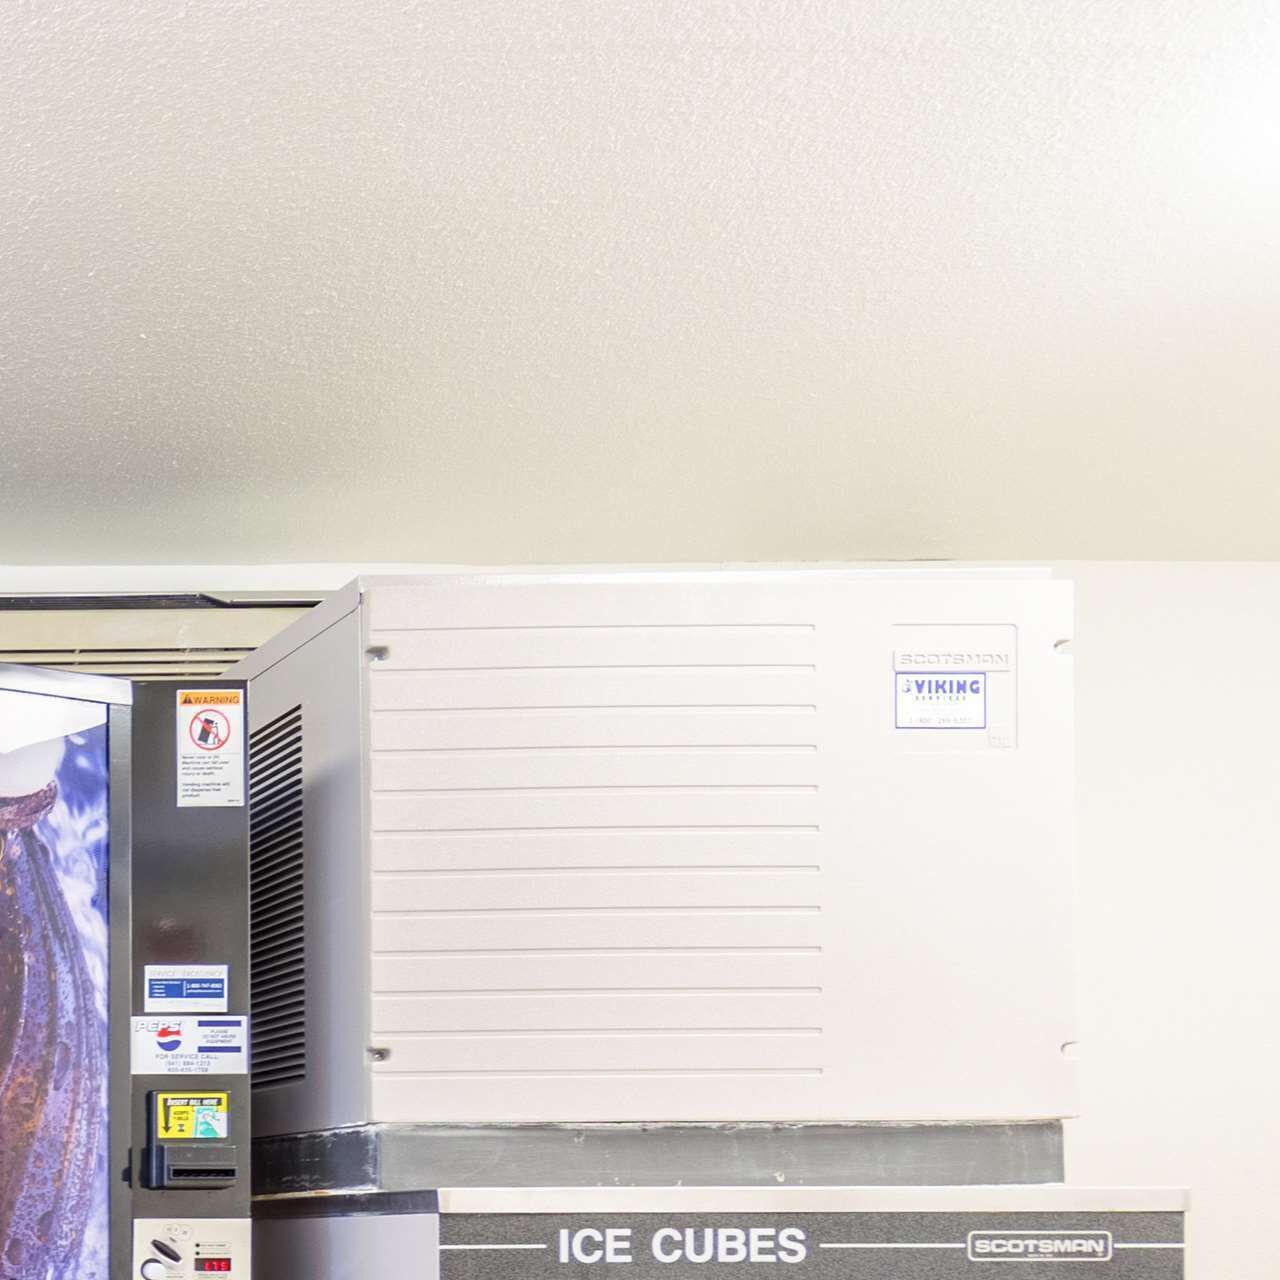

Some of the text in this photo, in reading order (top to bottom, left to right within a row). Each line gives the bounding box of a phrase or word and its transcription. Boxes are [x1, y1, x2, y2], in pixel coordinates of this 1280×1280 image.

[900, 654, 1009, 665] SCOTSMAN
[914, 680, 981, 694] VIKING
[193, 695, 239, 704] WARNING
[135, 1021, 183, 1033] PEPSI
[559, 1227, 807, 1264] ICE CUBES
[975, 1239, 1105, 1253] SCOTSMAN
